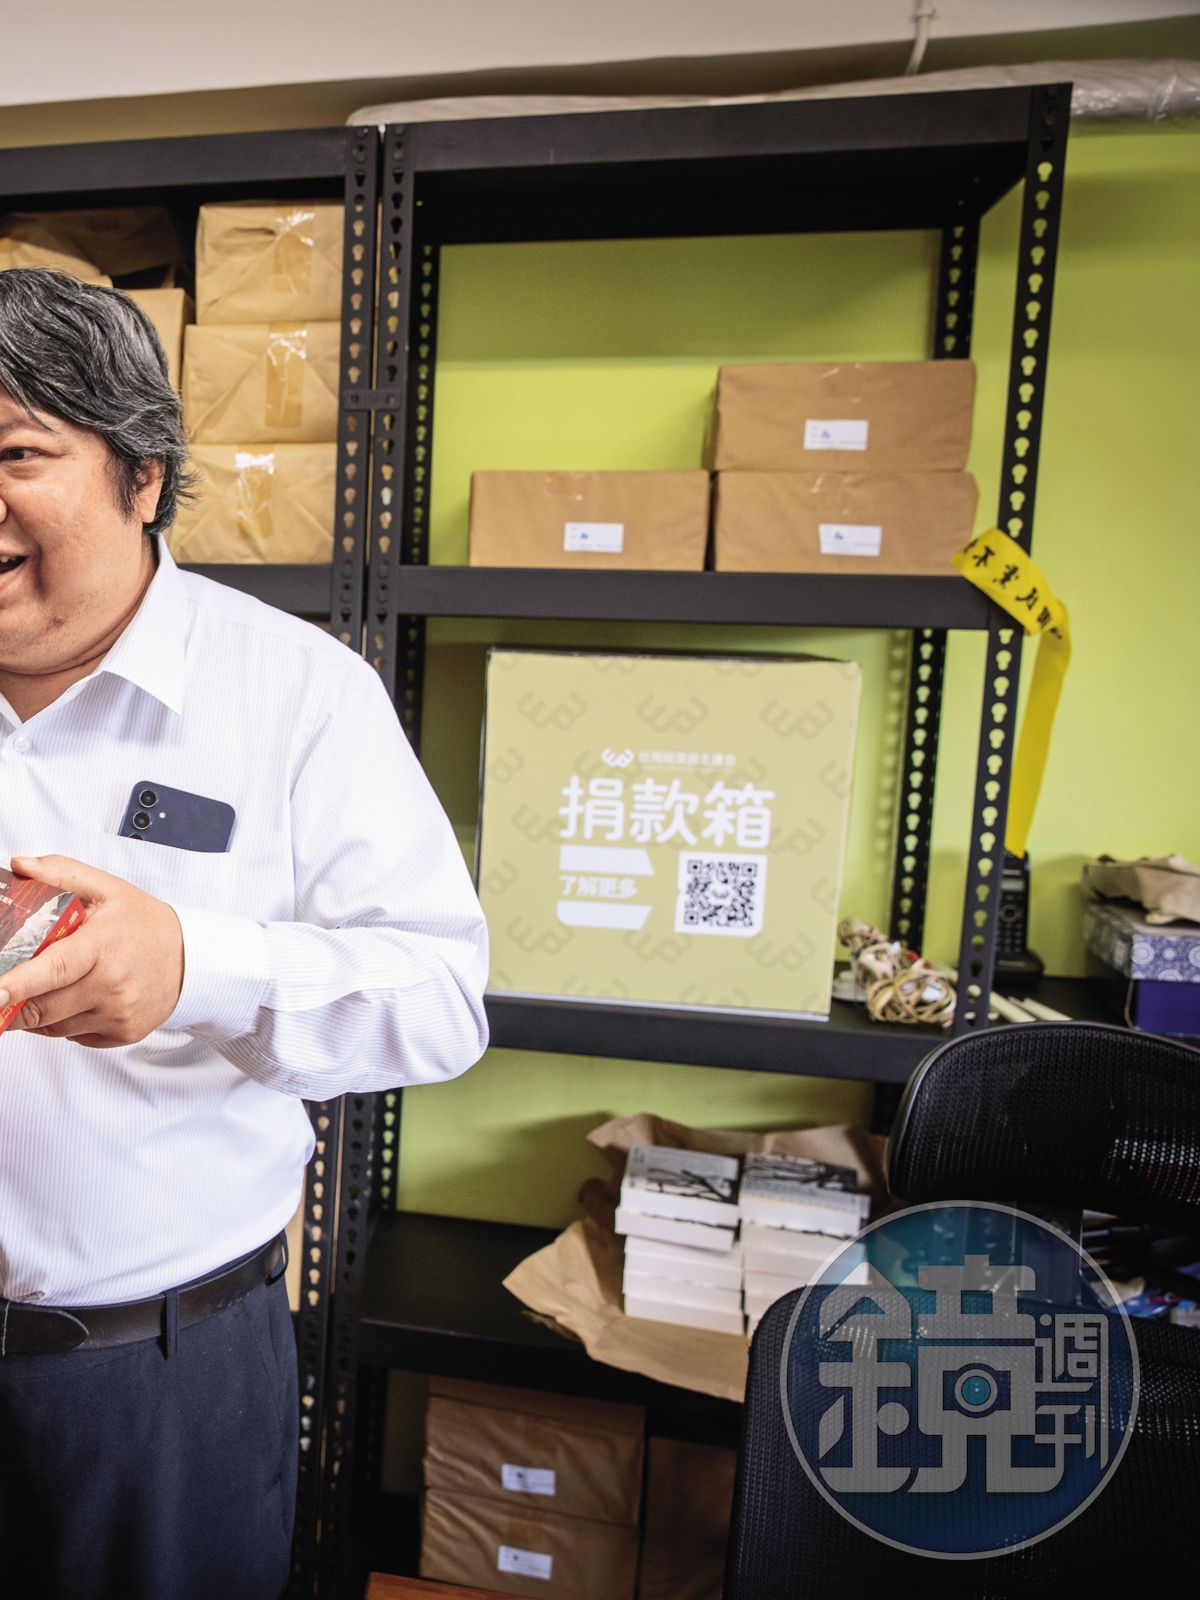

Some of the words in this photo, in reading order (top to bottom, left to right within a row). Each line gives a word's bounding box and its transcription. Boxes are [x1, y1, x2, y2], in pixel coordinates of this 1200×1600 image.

[558, 775, 776, 849] 捐款箱
[558, 876, 638, 899] 了解更多
